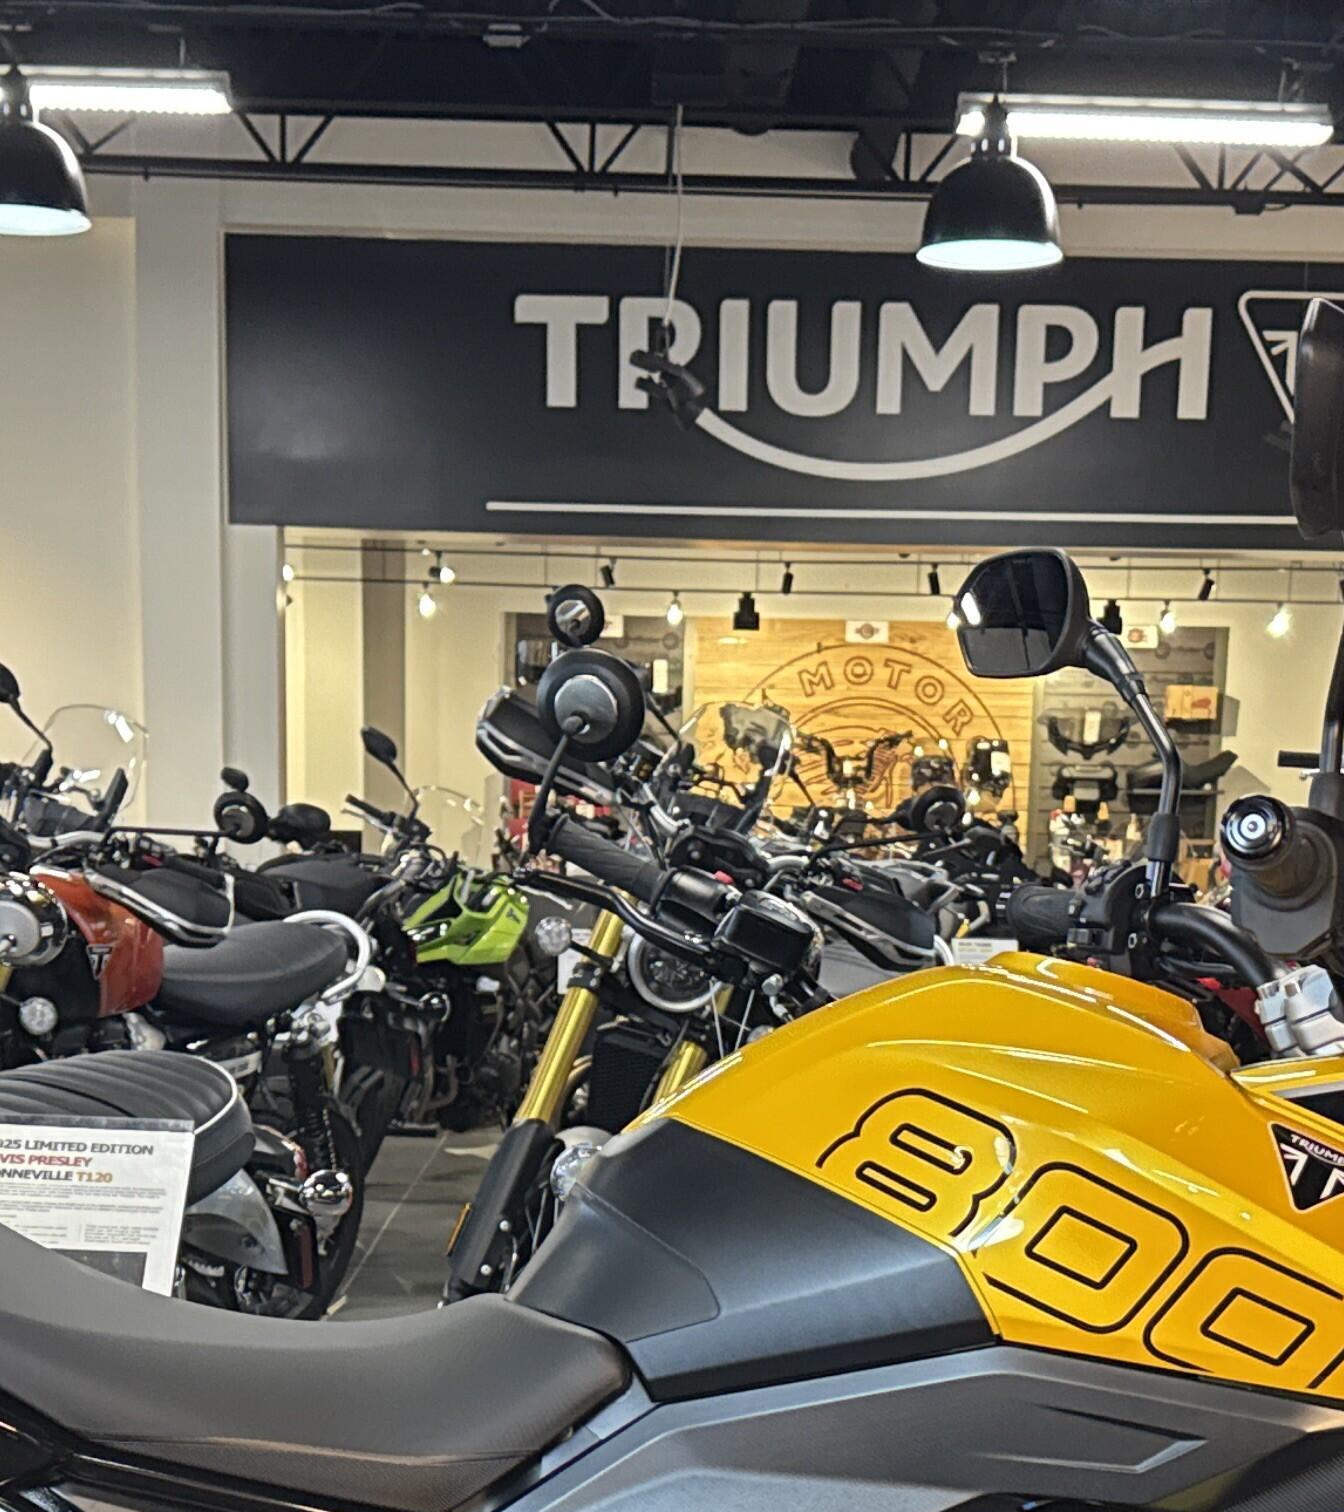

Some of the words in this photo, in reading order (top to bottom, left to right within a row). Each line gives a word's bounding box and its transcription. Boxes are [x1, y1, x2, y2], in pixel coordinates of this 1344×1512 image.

[513, 294, 1214, 482] TRIUMPH
[796, 655, 976, 737] MOTOR
[24, 1140, 88, 1154] LIMITED
[90, 1142, 154, 1156] EDITION
[28, 1154, 93, 1168] PRESLEY
[76, 1170, 113, 1184] T120
